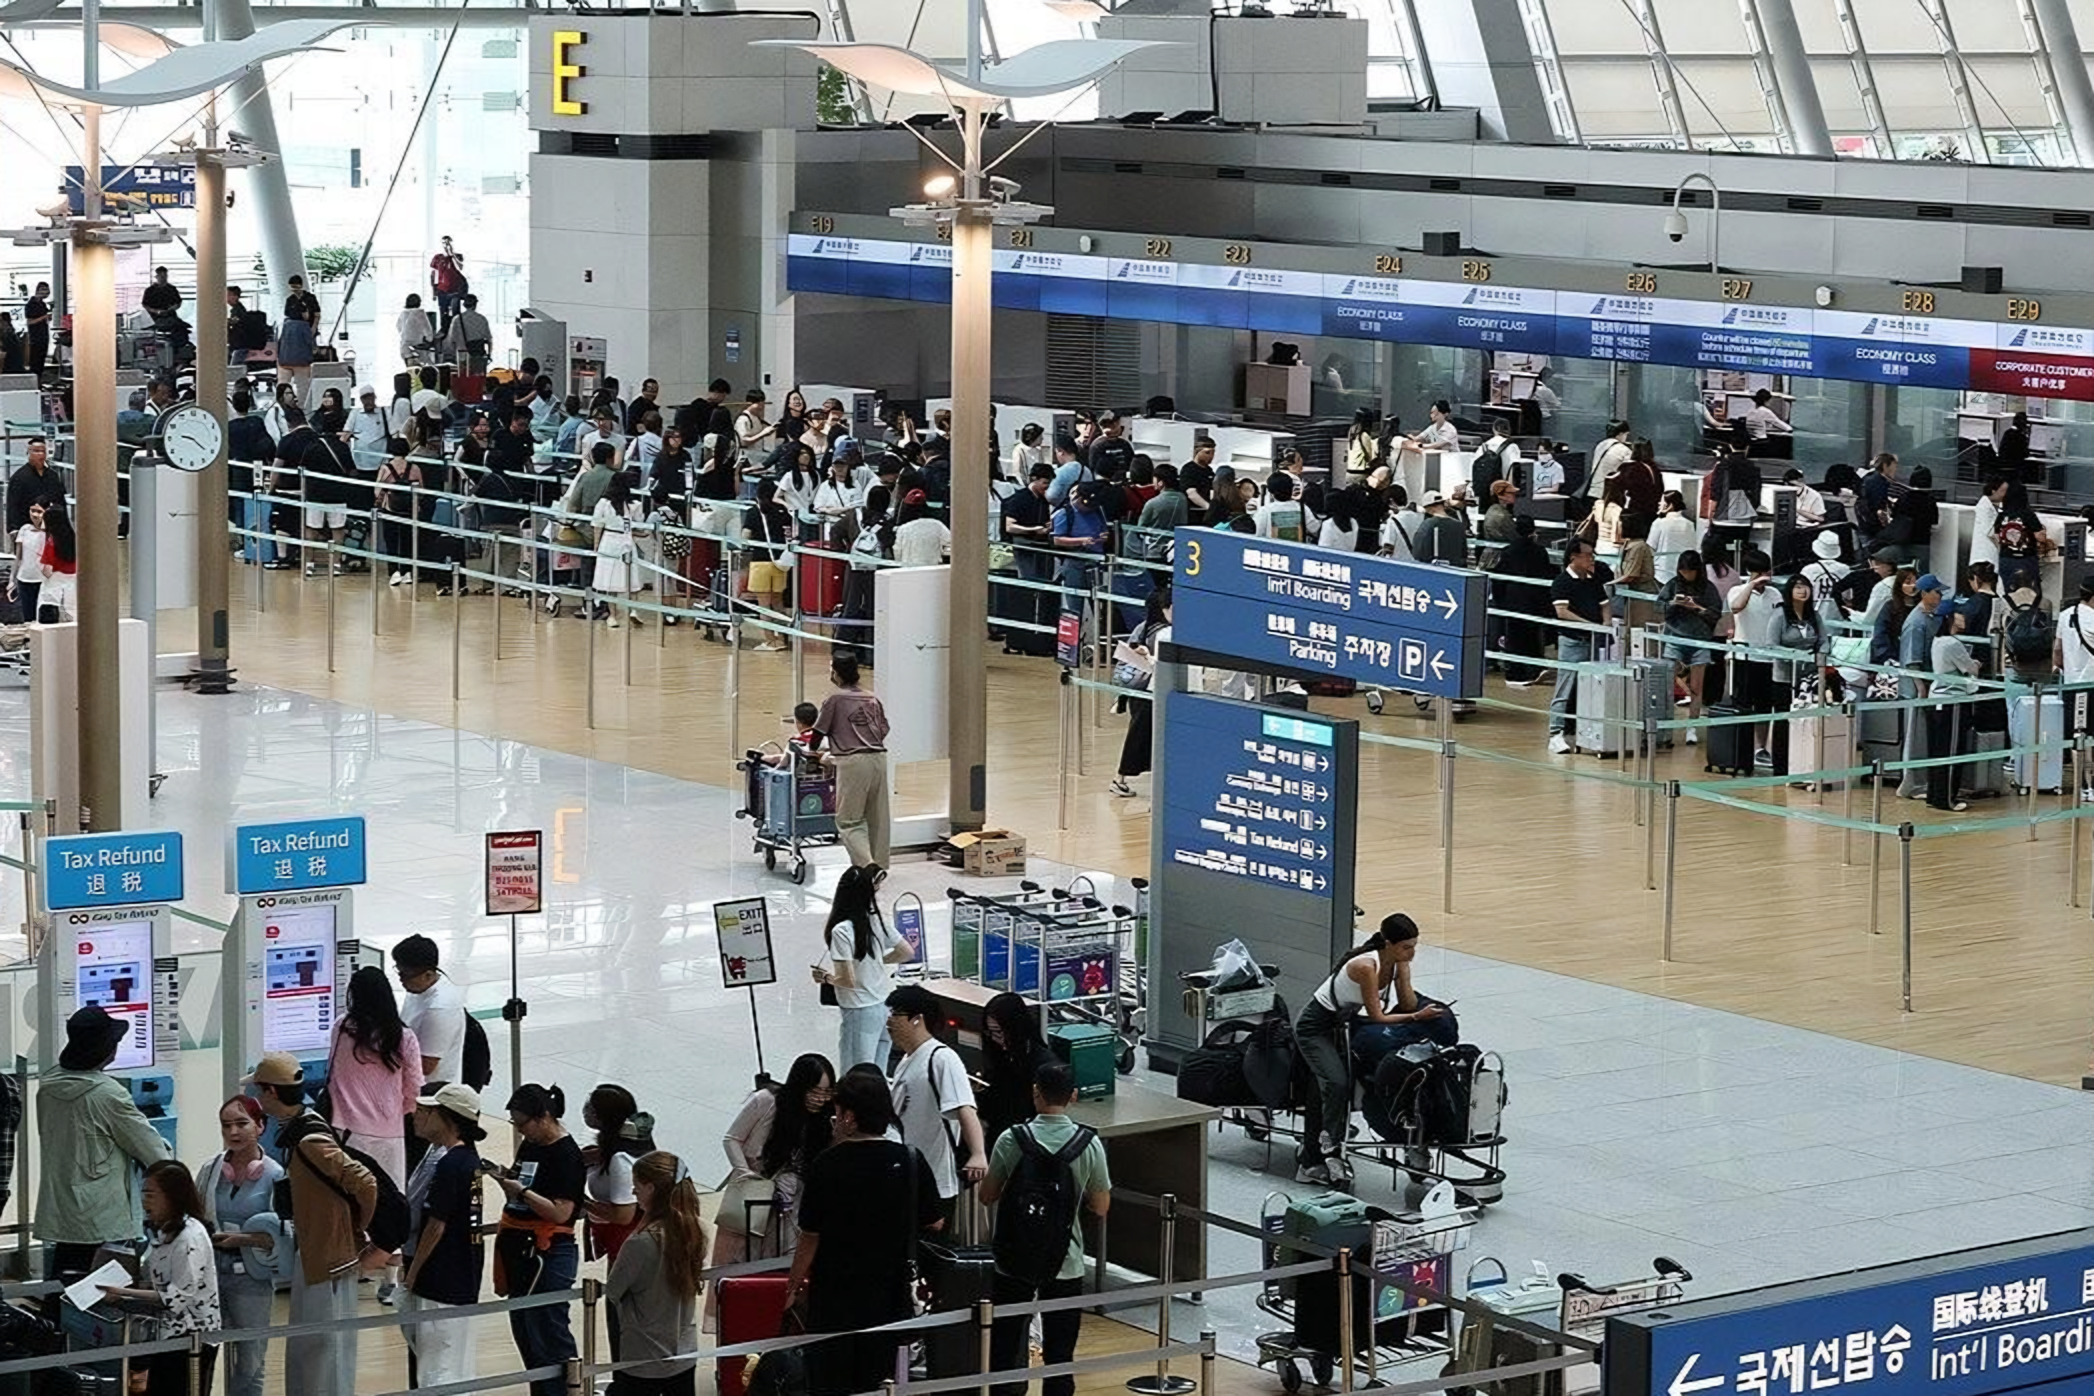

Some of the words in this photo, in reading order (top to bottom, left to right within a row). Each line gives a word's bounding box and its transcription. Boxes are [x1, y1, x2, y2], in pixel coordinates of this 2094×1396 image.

[553, 31, 587, 115] E
[1010, 230, 1033, 247] E21
[1146, 238, 1171, 258] E22
[1224, 245, 1251, 264] E23
[1375, 255, 1402, 274] E24
[1462, 261, 1490, 281] E25
[1626, 273, 1656, 293] E26
[1721, 279, 1752, 299] E27
[1337, 306, 1376, 318] ECONOMY
[1902, 291, 1935, 313] E28
[2007, 299, 2041, 320] E29
[1458, 315, 1498, 328] ECONOMY
[1856, 347, 1904, 361] ECONOMY
[1905, 351, 1937, 365] CLASS
[1995, 361, 2046, 374] CORPORATE
[1185, 540, 1201, 576] 3
[1267, 576, 1292, 595] Int'l
[1293, 580, 1351, 611] Boarding
[1289, 640, 1337, 669] Parking
[1404, 645, 1421, 675] P
[250, 836, 282, 855] Tax
[286, 828, 349, 851] Refund
[60, 851, 93, 869] Tax
[99, 844, 165, 867] Refund
[1932, 1277, 2048, 1332] 国际线登机
[1736, 1323, 1911, 1396] 국제선탑승
[1931, 1334, 1987, 1381] Int'l
